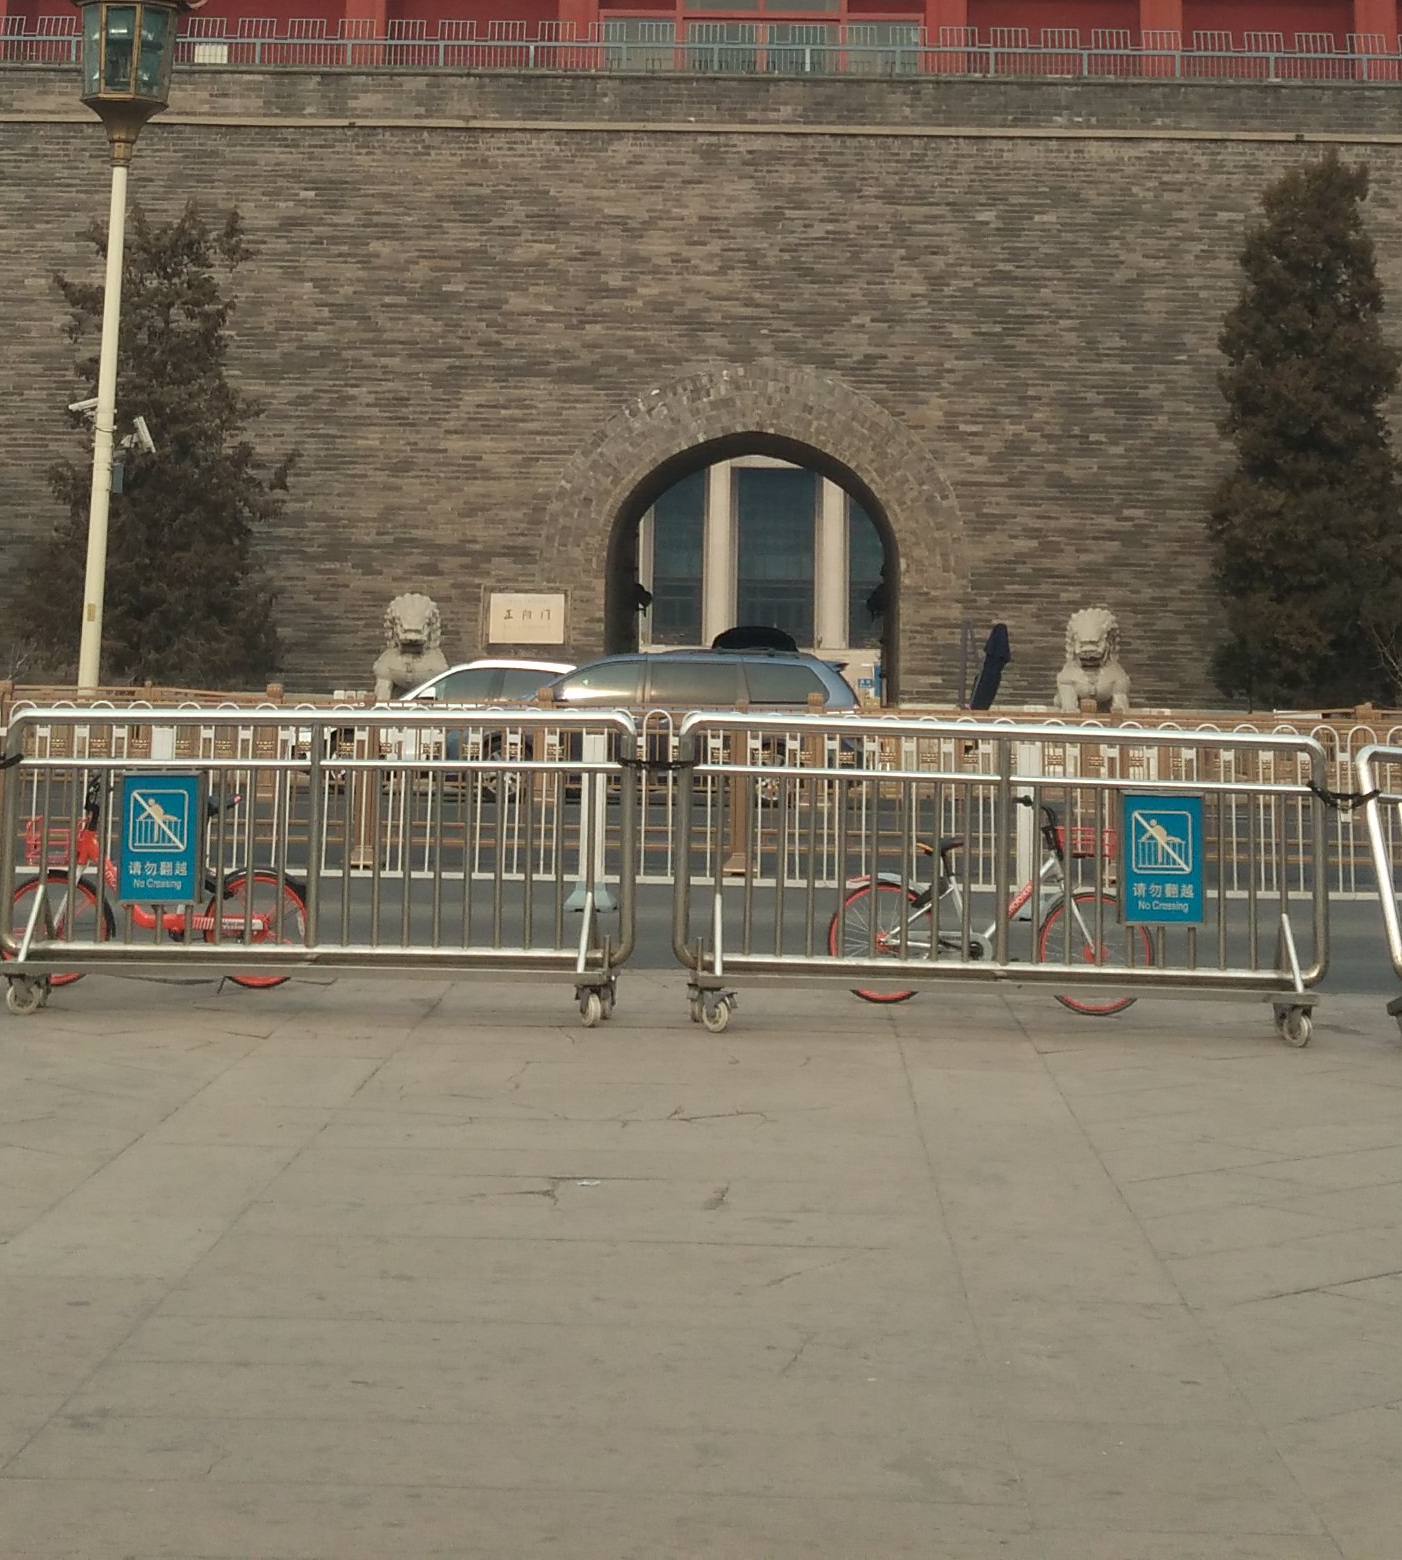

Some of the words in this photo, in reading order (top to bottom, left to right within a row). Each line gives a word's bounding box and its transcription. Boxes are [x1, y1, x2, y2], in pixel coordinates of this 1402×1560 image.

[128, 861, 188, 876] 请勿翻越
[133, 878, 145, 888] No
[146, 878, 182, 891] Crossing
[1132, 883, 1195, 898] 请勿翻越
[1138, 901, 1151, 910] No
[1152, 901, 1189, 913] Crossing
